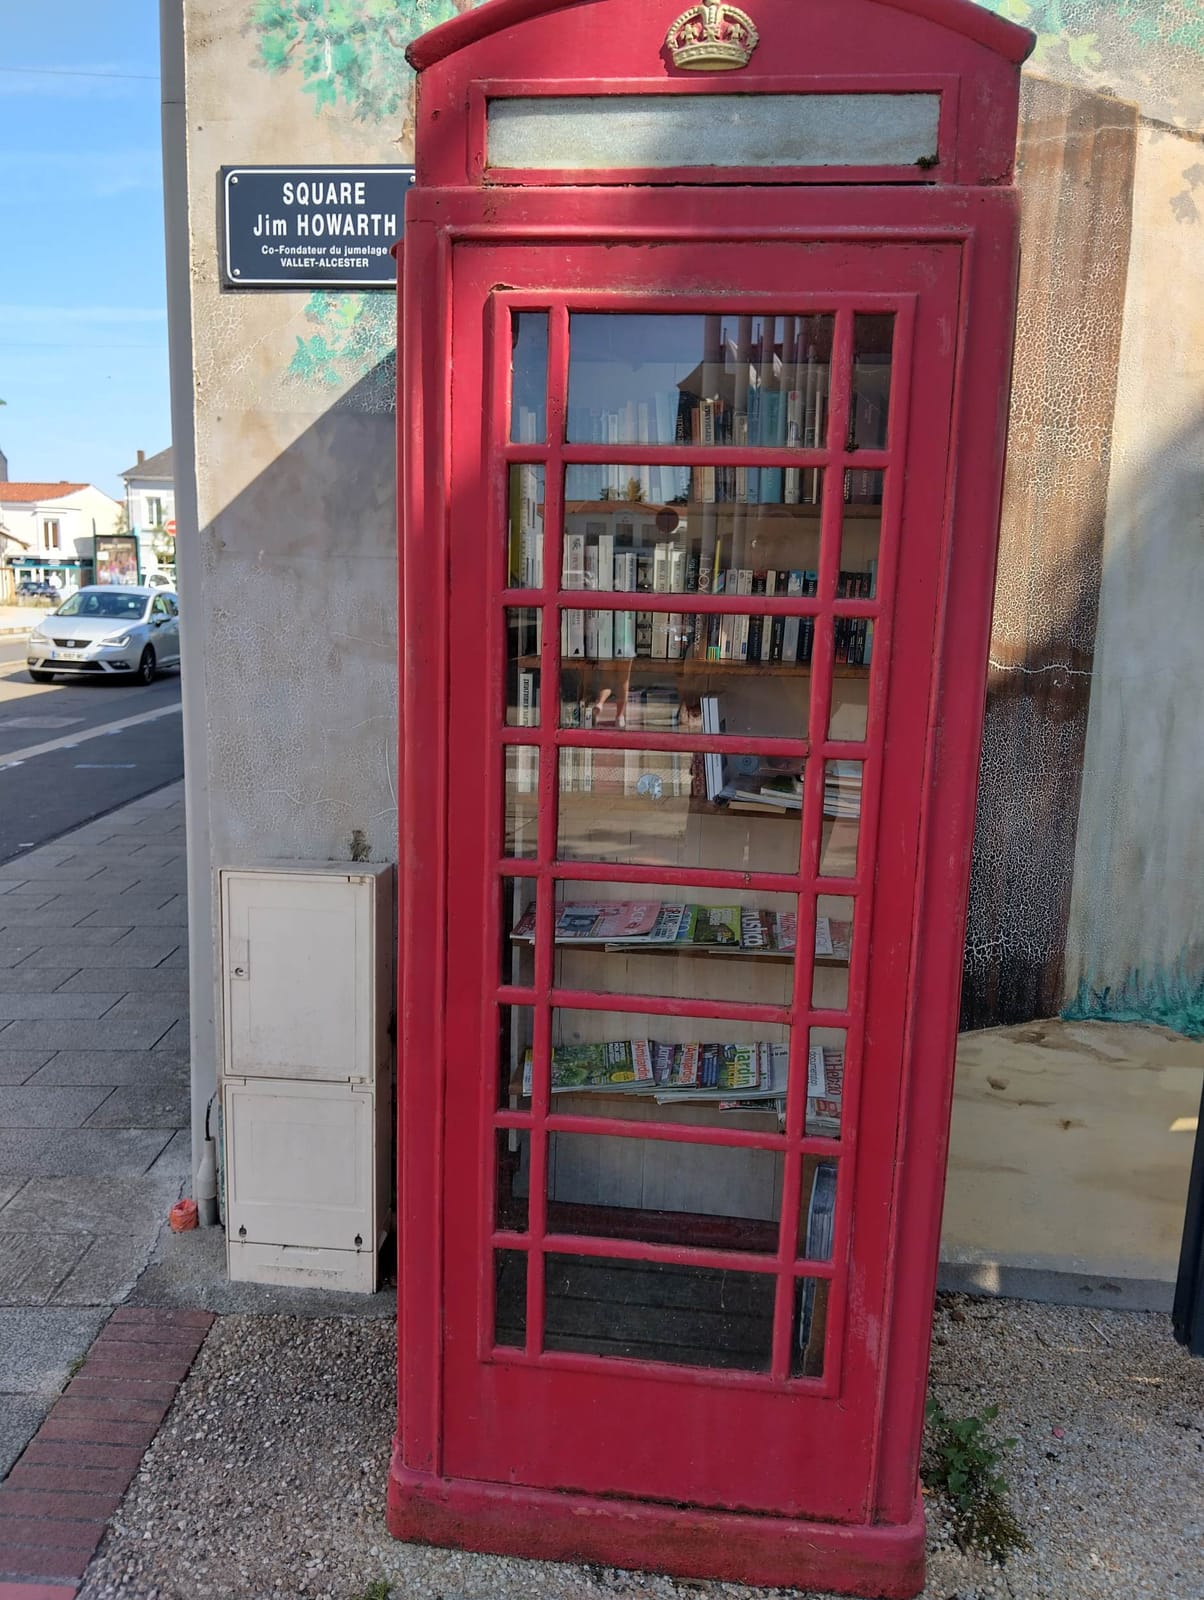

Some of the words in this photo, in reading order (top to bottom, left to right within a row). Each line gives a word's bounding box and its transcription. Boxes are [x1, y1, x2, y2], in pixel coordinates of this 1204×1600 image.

[282, 182, 366, 205] SQUARE
[253, 214, 287, 236] Jim
[297, 213, 396, 236] HOWARTH
[261, 245, 326, 255] Co-Fondateur
[329, 245, 342, 255] du
[344, 245, 388, 256] jumelage
[280, 258, 369, 268] VALLET-ALCESTER
[742, 911, 768, 946] rustica
[736, 1047, 756, 1086] jardin
[824, 1053, 844, 1096] L'Hebdo
